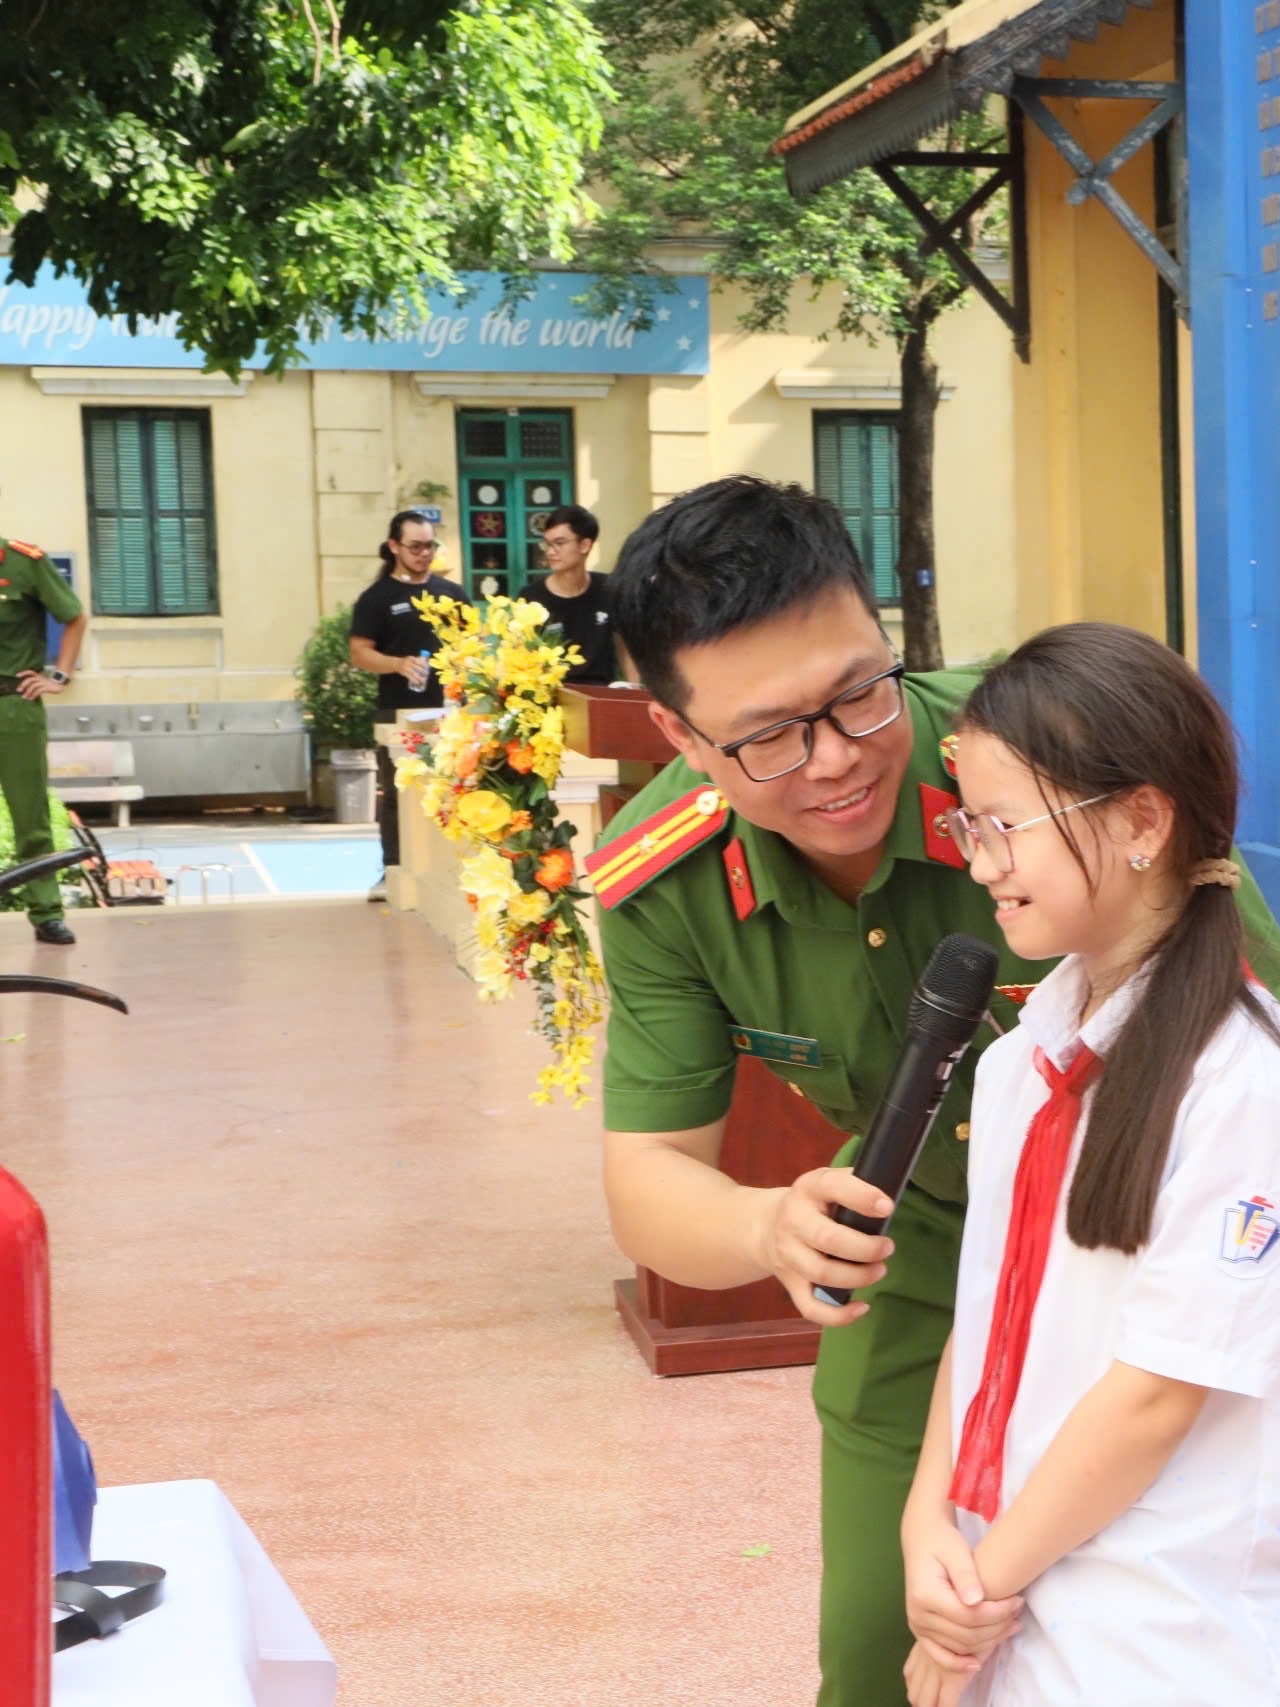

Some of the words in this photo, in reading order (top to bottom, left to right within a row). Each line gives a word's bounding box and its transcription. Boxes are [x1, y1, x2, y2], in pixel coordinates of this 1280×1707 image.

[0, 286, 97, 351] appy
[479, 302, 530, 348] the
[538, 305, 645, 350] world
